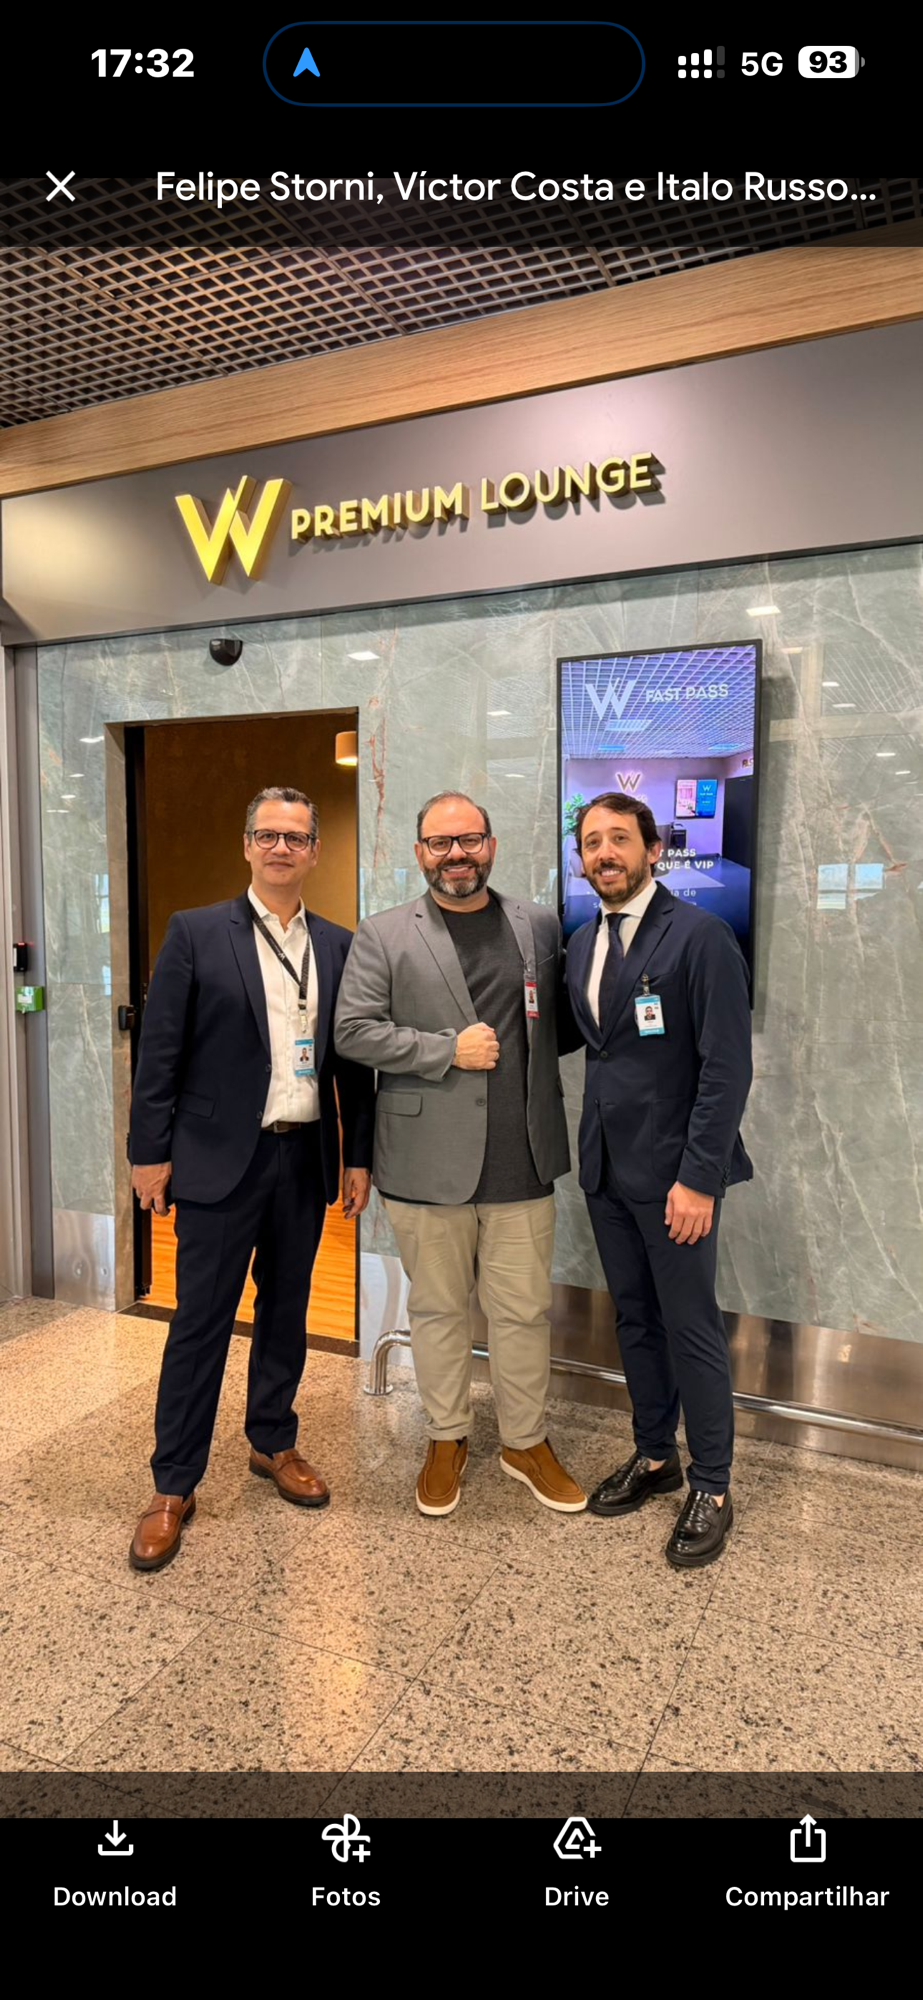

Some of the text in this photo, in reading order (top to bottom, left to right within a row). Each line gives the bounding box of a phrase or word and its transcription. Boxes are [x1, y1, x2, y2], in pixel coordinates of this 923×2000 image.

[291, 482, 469, 541] PREMIUM
[481, 451, 660, 515] LOUNGE
[646, 687, 682, 704] FAST
[685, 683, 729, 701] PASS
[667, 848, 697, 858] PASS
[657, 860, 681, 871] QUE
[694, 860, 714, 870] VIP
[683, 887, 697, 898] de
